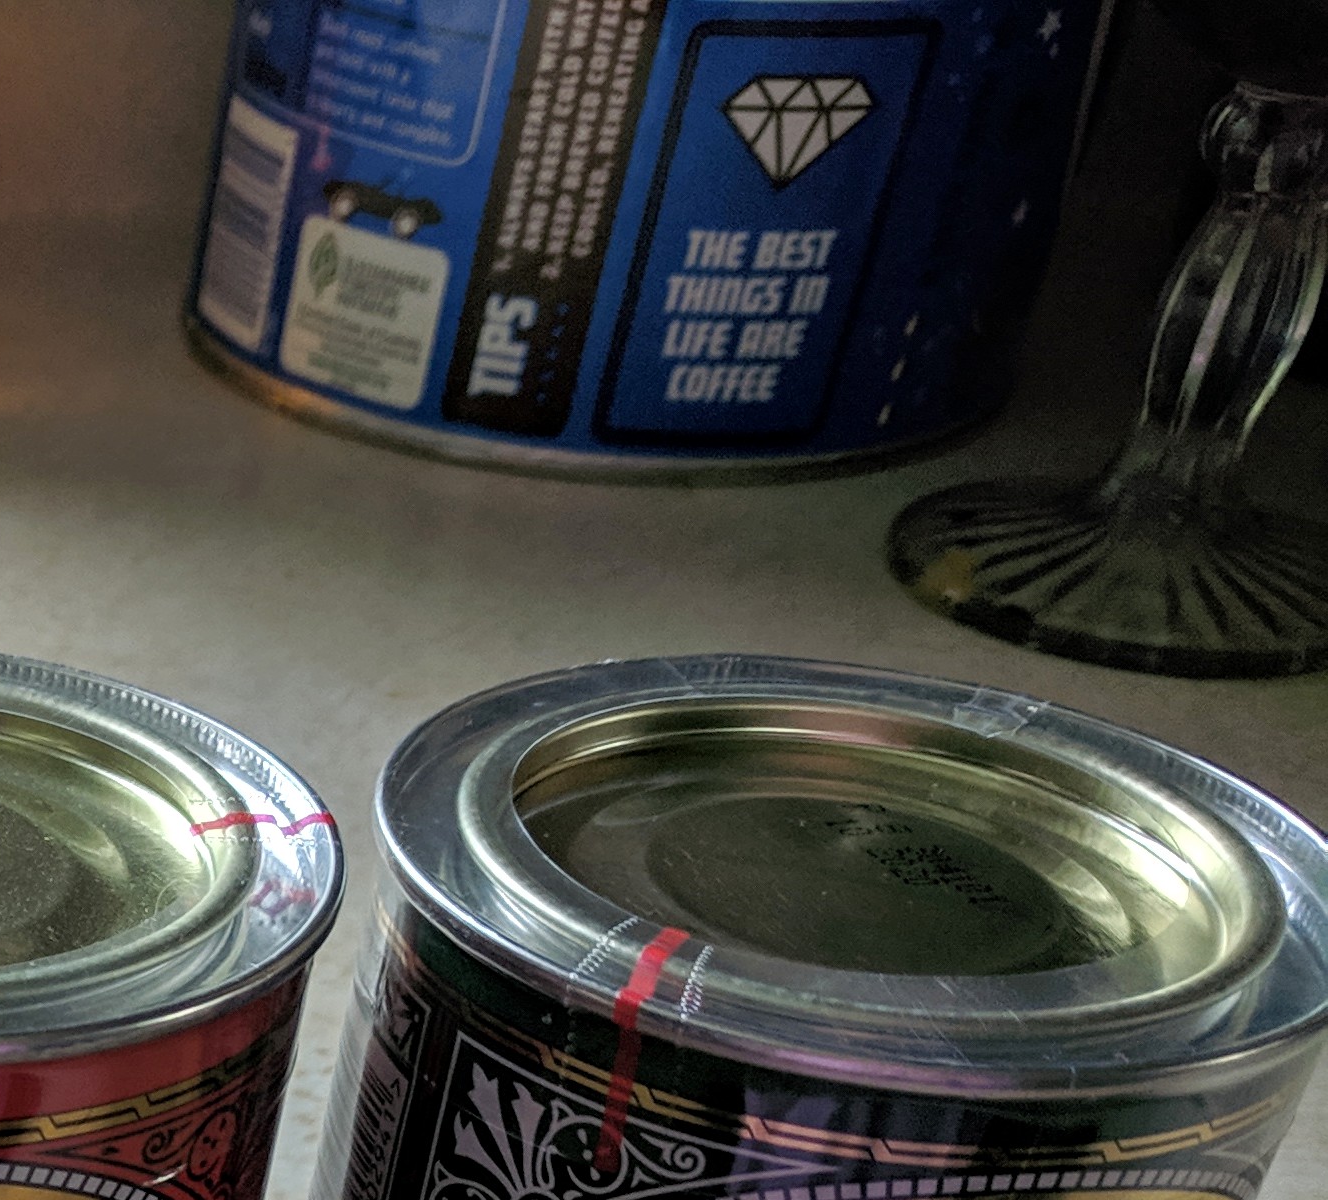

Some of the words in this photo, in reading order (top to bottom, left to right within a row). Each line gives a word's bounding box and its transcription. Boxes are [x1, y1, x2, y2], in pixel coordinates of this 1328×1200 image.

[536, 6, 569, 74] WITH
[519, 75, 554, 156] START
[684, 229, 748, 269] THE
[752, 229, 838, 270] BEST
[664, 275, 786, 314] THINGS
[791, 274, 830, 314] IN
[467, 292, 538, 396] TIPS
[662, 321, 731, 359] LIFE
[737, 321, 806, 359] ARE
[666, 364, 781, 403] COFFEE
